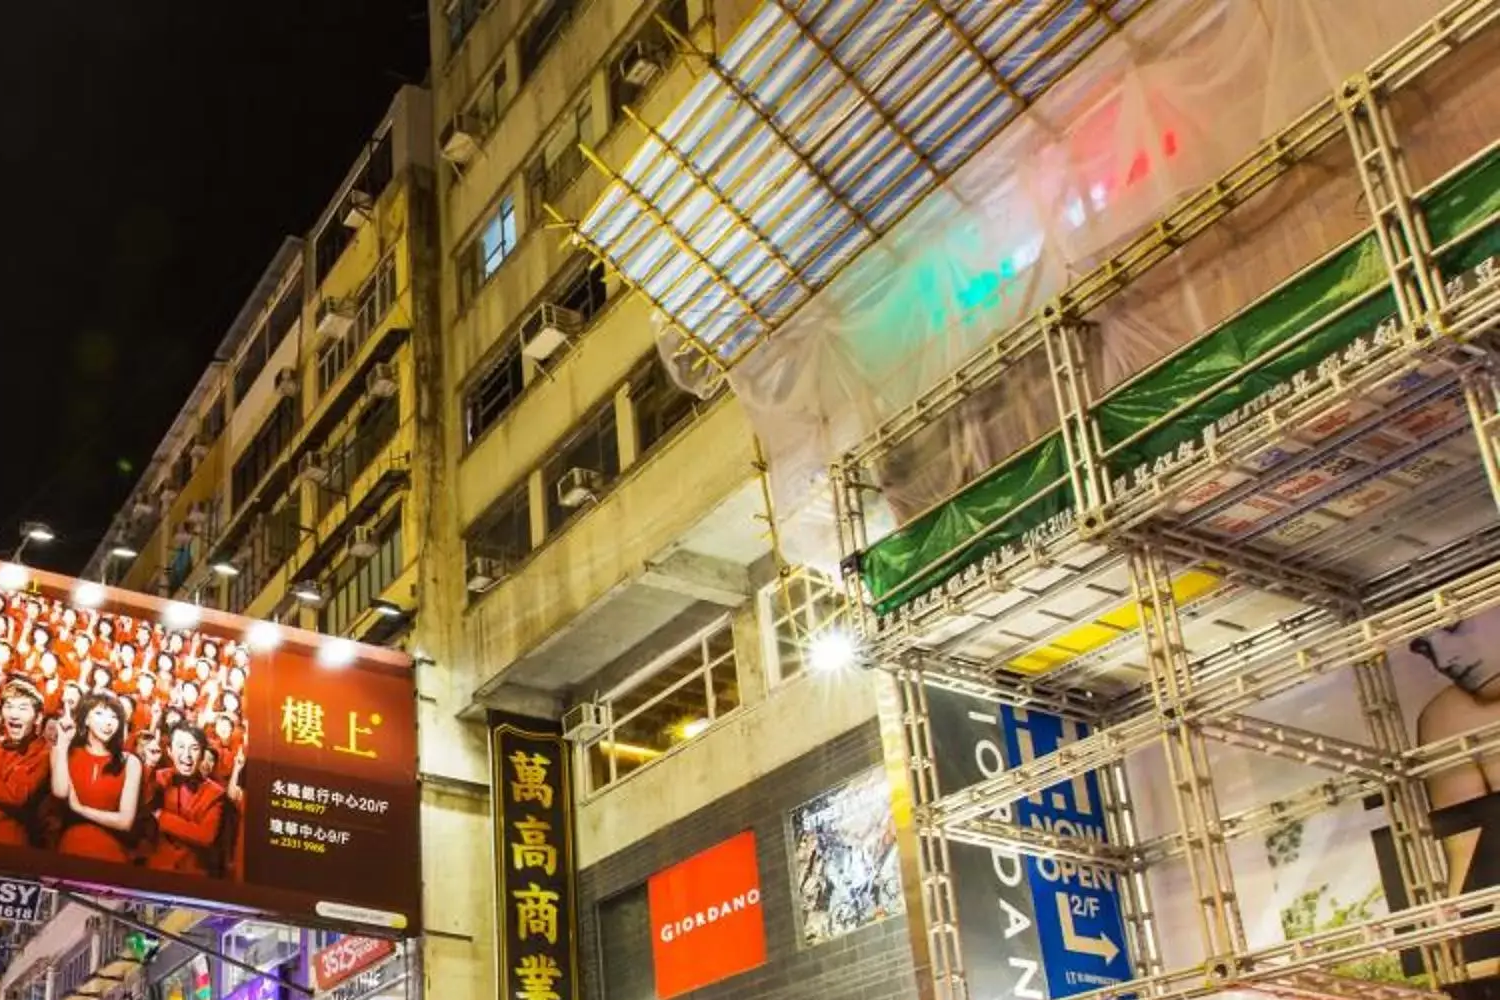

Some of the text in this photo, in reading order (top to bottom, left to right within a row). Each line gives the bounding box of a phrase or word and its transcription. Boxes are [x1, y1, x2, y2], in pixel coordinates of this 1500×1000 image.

[281, 695, 378, 759] 樓上
[1037, 852, 1114, 893] OPEN
[660, 888, 761, 943] GIORDANO
[1071, 894, 1101, 919] 2/F
